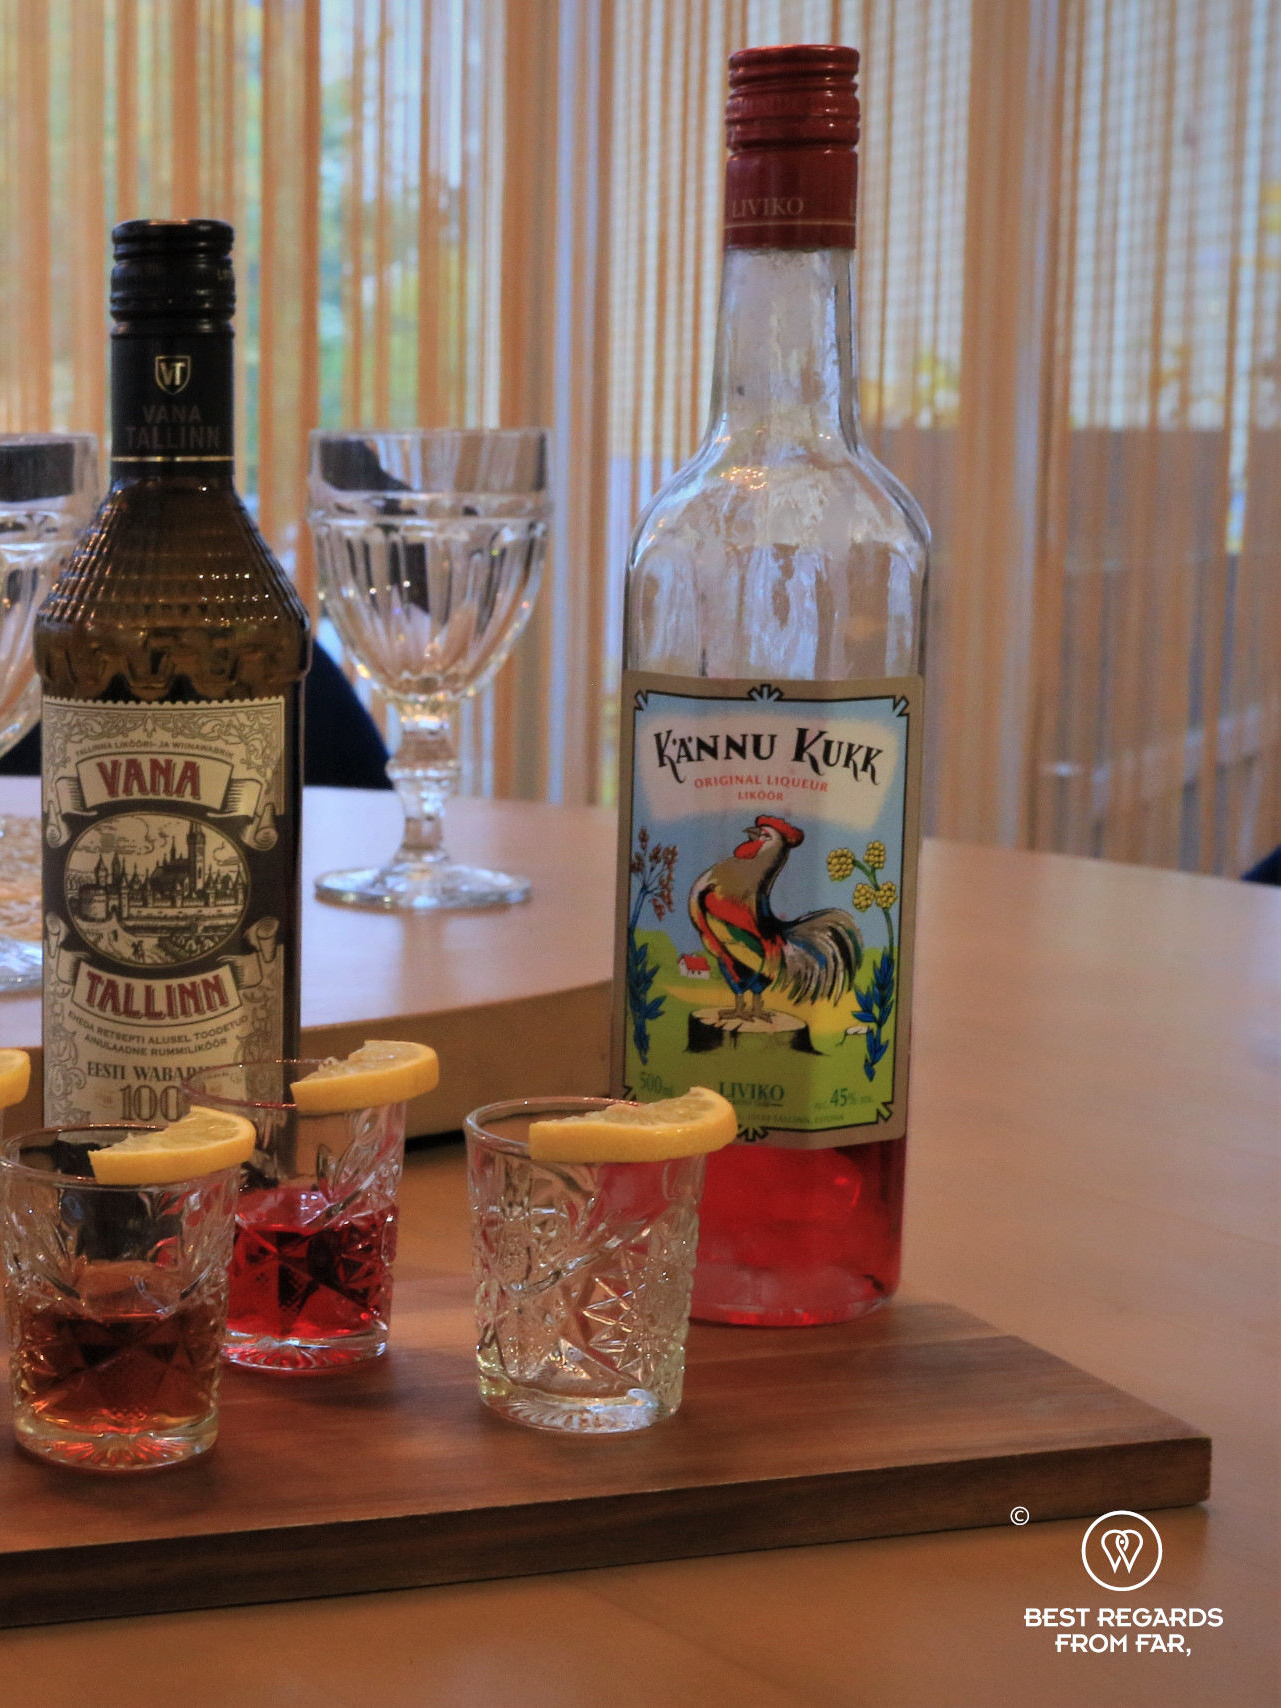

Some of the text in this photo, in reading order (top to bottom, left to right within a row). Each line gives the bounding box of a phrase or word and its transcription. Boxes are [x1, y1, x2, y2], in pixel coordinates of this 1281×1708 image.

[732, 197, 804, 218] LIVIKO
[159, 362, 186, 385] VT
[143, 404, 202, 423] VANA
[124, 426, 220, 449] TALLINN
[791, 728, 883, 785] KUKK
[96, 758, 201, 800] VANA
[694, 775, 829, 793] ORIGINAL LIQUEUR
[85, 970, 230, 1020] TALLINN
[68, 1010, 249, 1046] EHEDA RETSEPTI ALUSEL TOODETUD
[84, 1033, 148, 1057] AINULAADNE
[86, 1061, 126, 1080] EESTI
[719, 1081, 785, 1101] LIVIKO
[119, 1083, 184, 1123] 100
